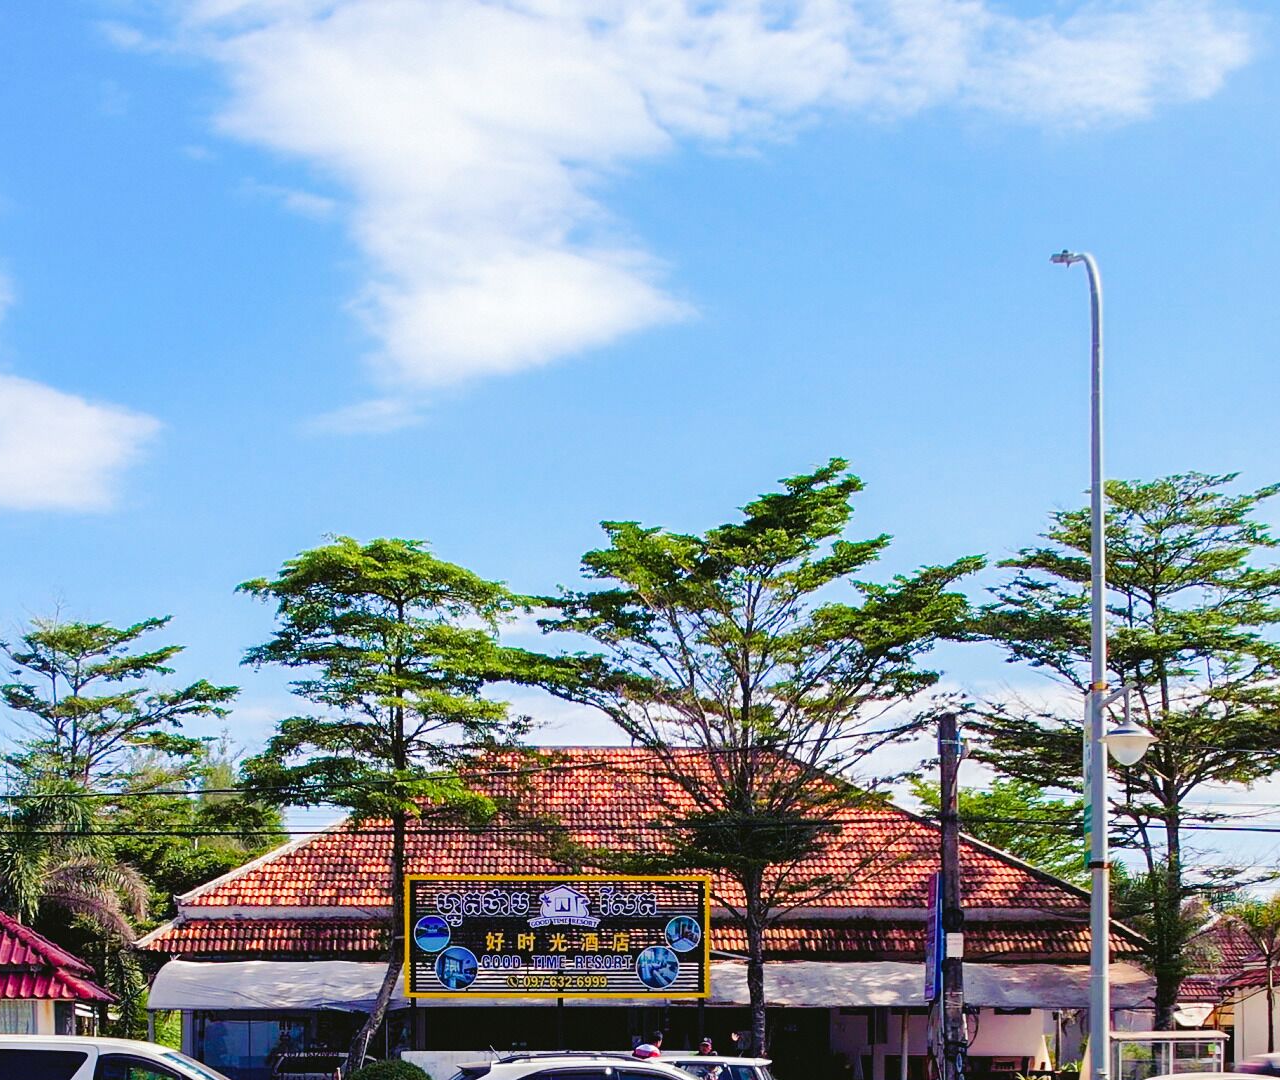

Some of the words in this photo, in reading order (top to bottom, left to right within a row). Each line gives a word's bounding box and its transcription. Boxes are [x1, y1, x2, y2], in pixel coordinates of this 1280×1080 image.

[530, 919, 550, 928] GOOD
[571, 919, 598, 928] RESORT
[485, 931, 631, 953] 好时光酒店
[481, 955, 522, 969] GOOD
[532, 955, 567, 969] TIME
[575, 955, 632, 969] RESORT
[523, 976, 545, 988] 097
[549, 976, 573, 988] 632
[576, 976, 608, 988] 6999
